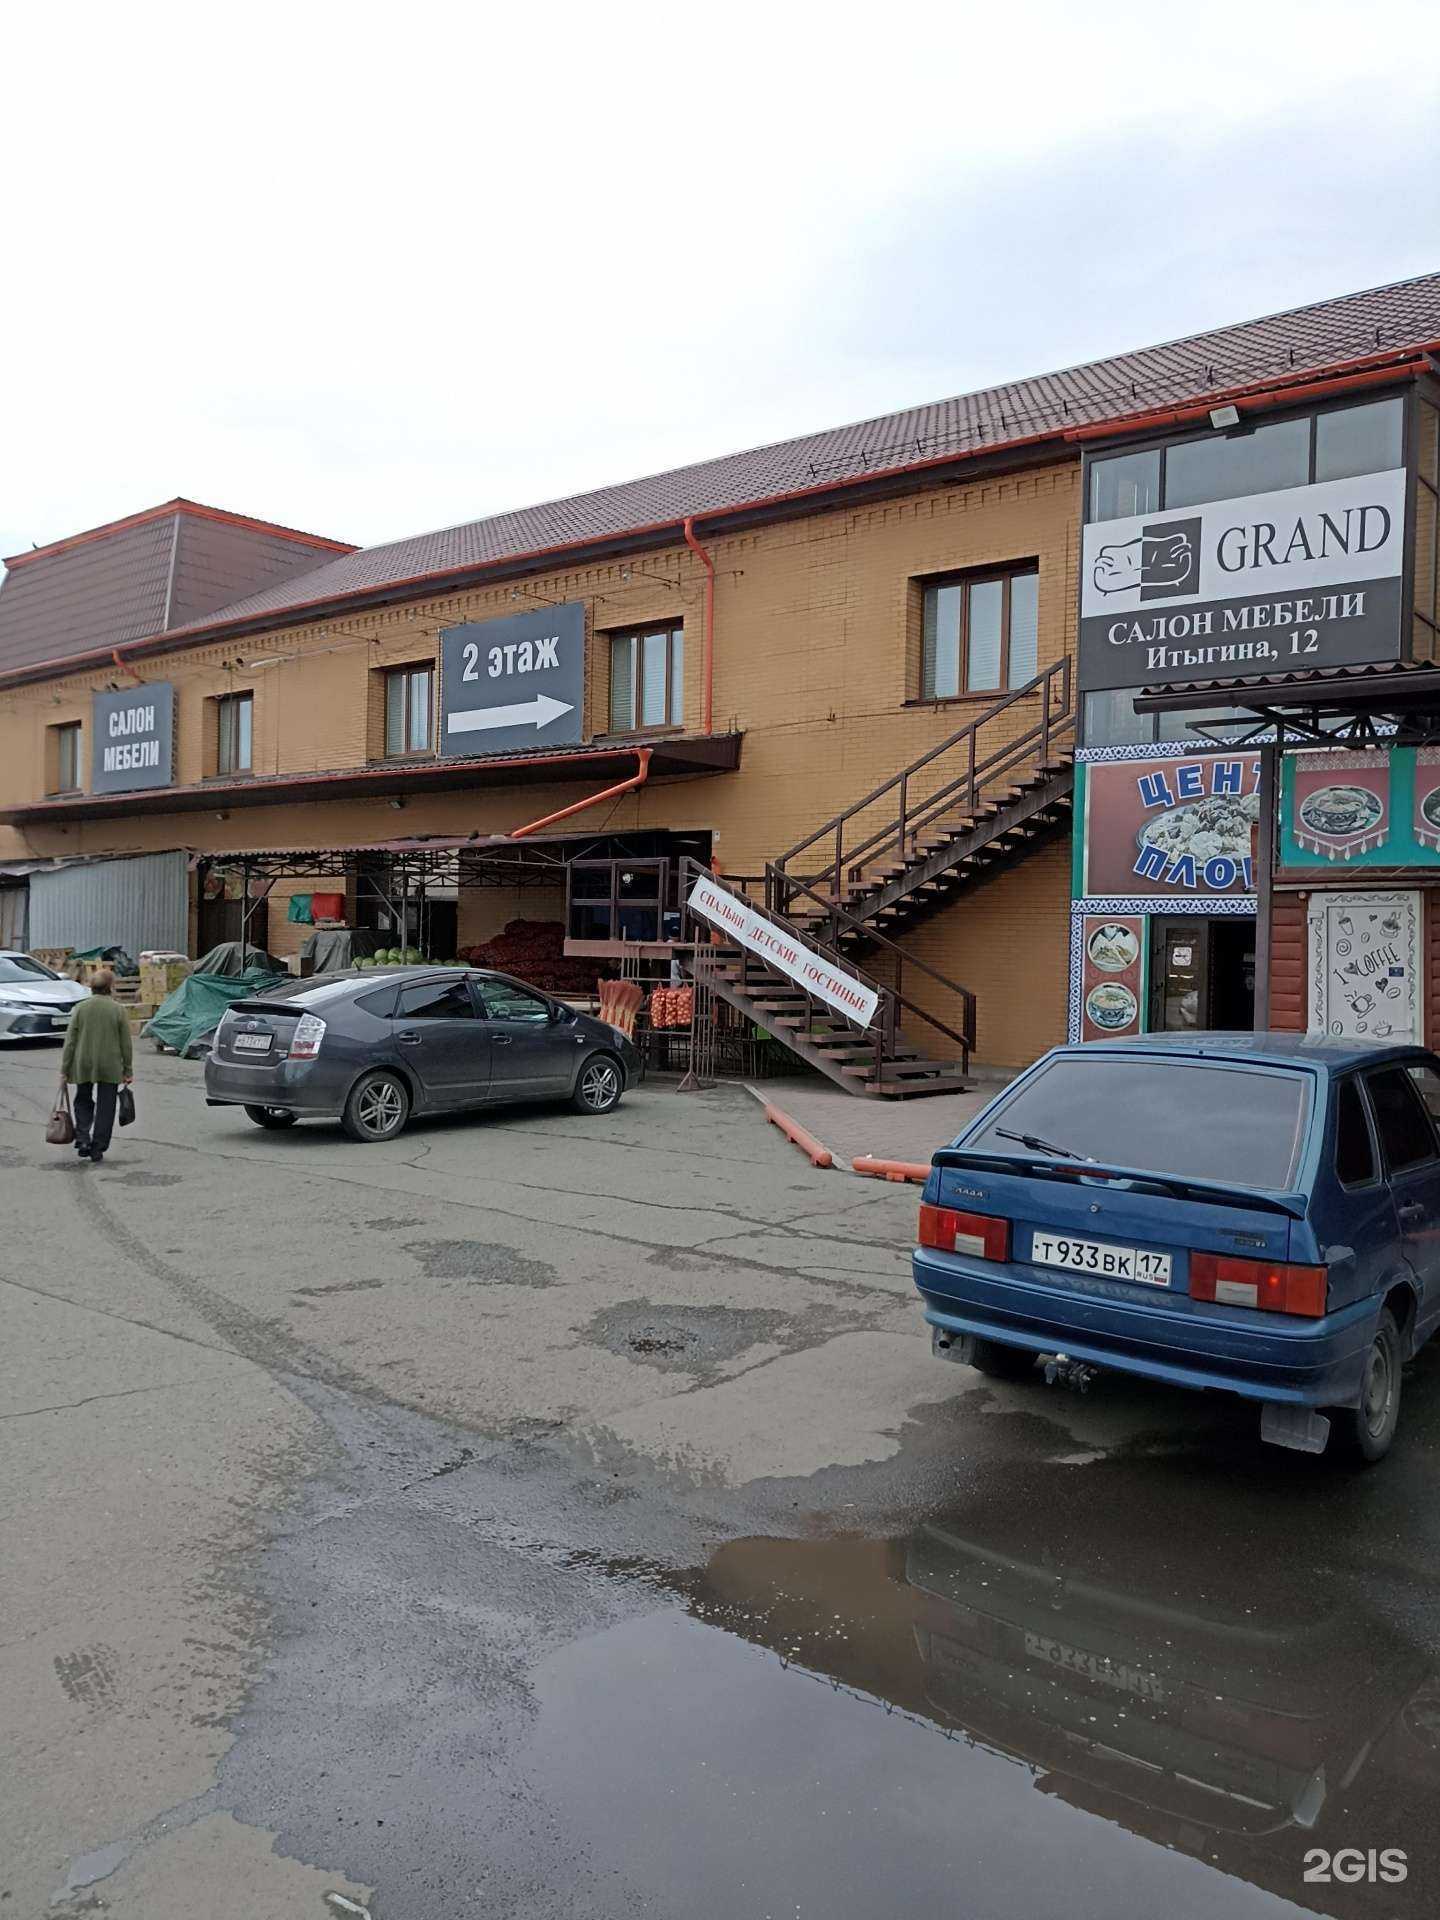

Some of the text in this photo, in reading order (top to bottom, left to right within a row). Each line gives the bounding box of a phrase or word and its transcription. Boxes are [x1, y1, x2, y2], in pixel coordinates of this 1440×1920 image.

[1216, 504, 1392, 573] GRAND
[1107, 591, 1367, 645] САЛОН МЕБЕЛИ
[462, 636, 560, 682] 2 этаж
[1145, 629, 1319, 670] Итыгина, 12
[108, 705, 155, 737] САЛОН
[103, 740, 160, 772] МЕБЕЛИ
[699, 889, 868, 1014] СПАЛЬНИ ДЕТСКИЕ ГОСТИНЫЕ
[1356, 942, 1401, 977] COFFEE
[1140, 1254, 1164, 1274] 17
